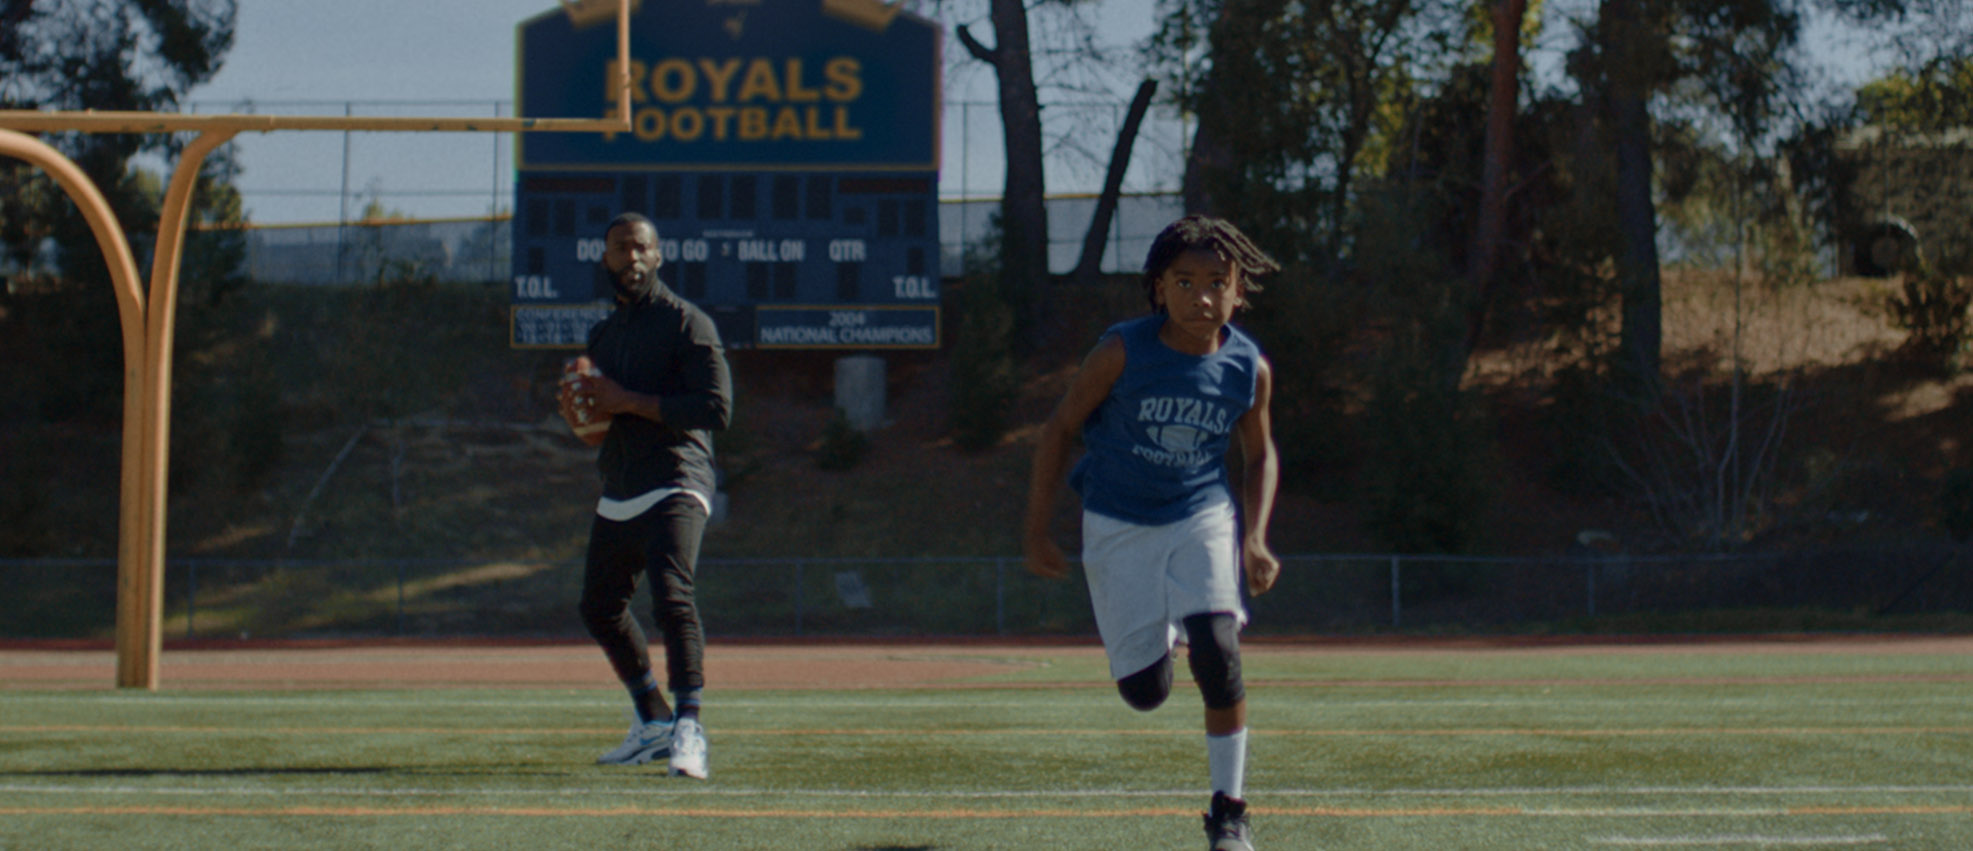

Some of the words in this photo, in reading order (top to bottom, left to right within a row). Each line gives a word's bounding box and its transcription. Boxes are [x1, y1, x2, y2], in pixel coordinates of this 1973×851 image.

[605, 58, 862, 102] ROYALS
[577, 239, 605, 262] DO
[682, 239, 706, 262] GO
[738, 239, 778, 262] BALL
[780, 239, 804, 262] ON
[829, 239, 866, 262] QTR
[515, 276, 557, 298] T.O.L.
[893, 276, 936, 298] T.O.L.
[829, 311, 865, 326] 2004
[760, 327, 837, 343] NATIONAL
[840, 327, 932, 343] CHAMPIONS
[1138, 397, 1227, 435] ROYALS
